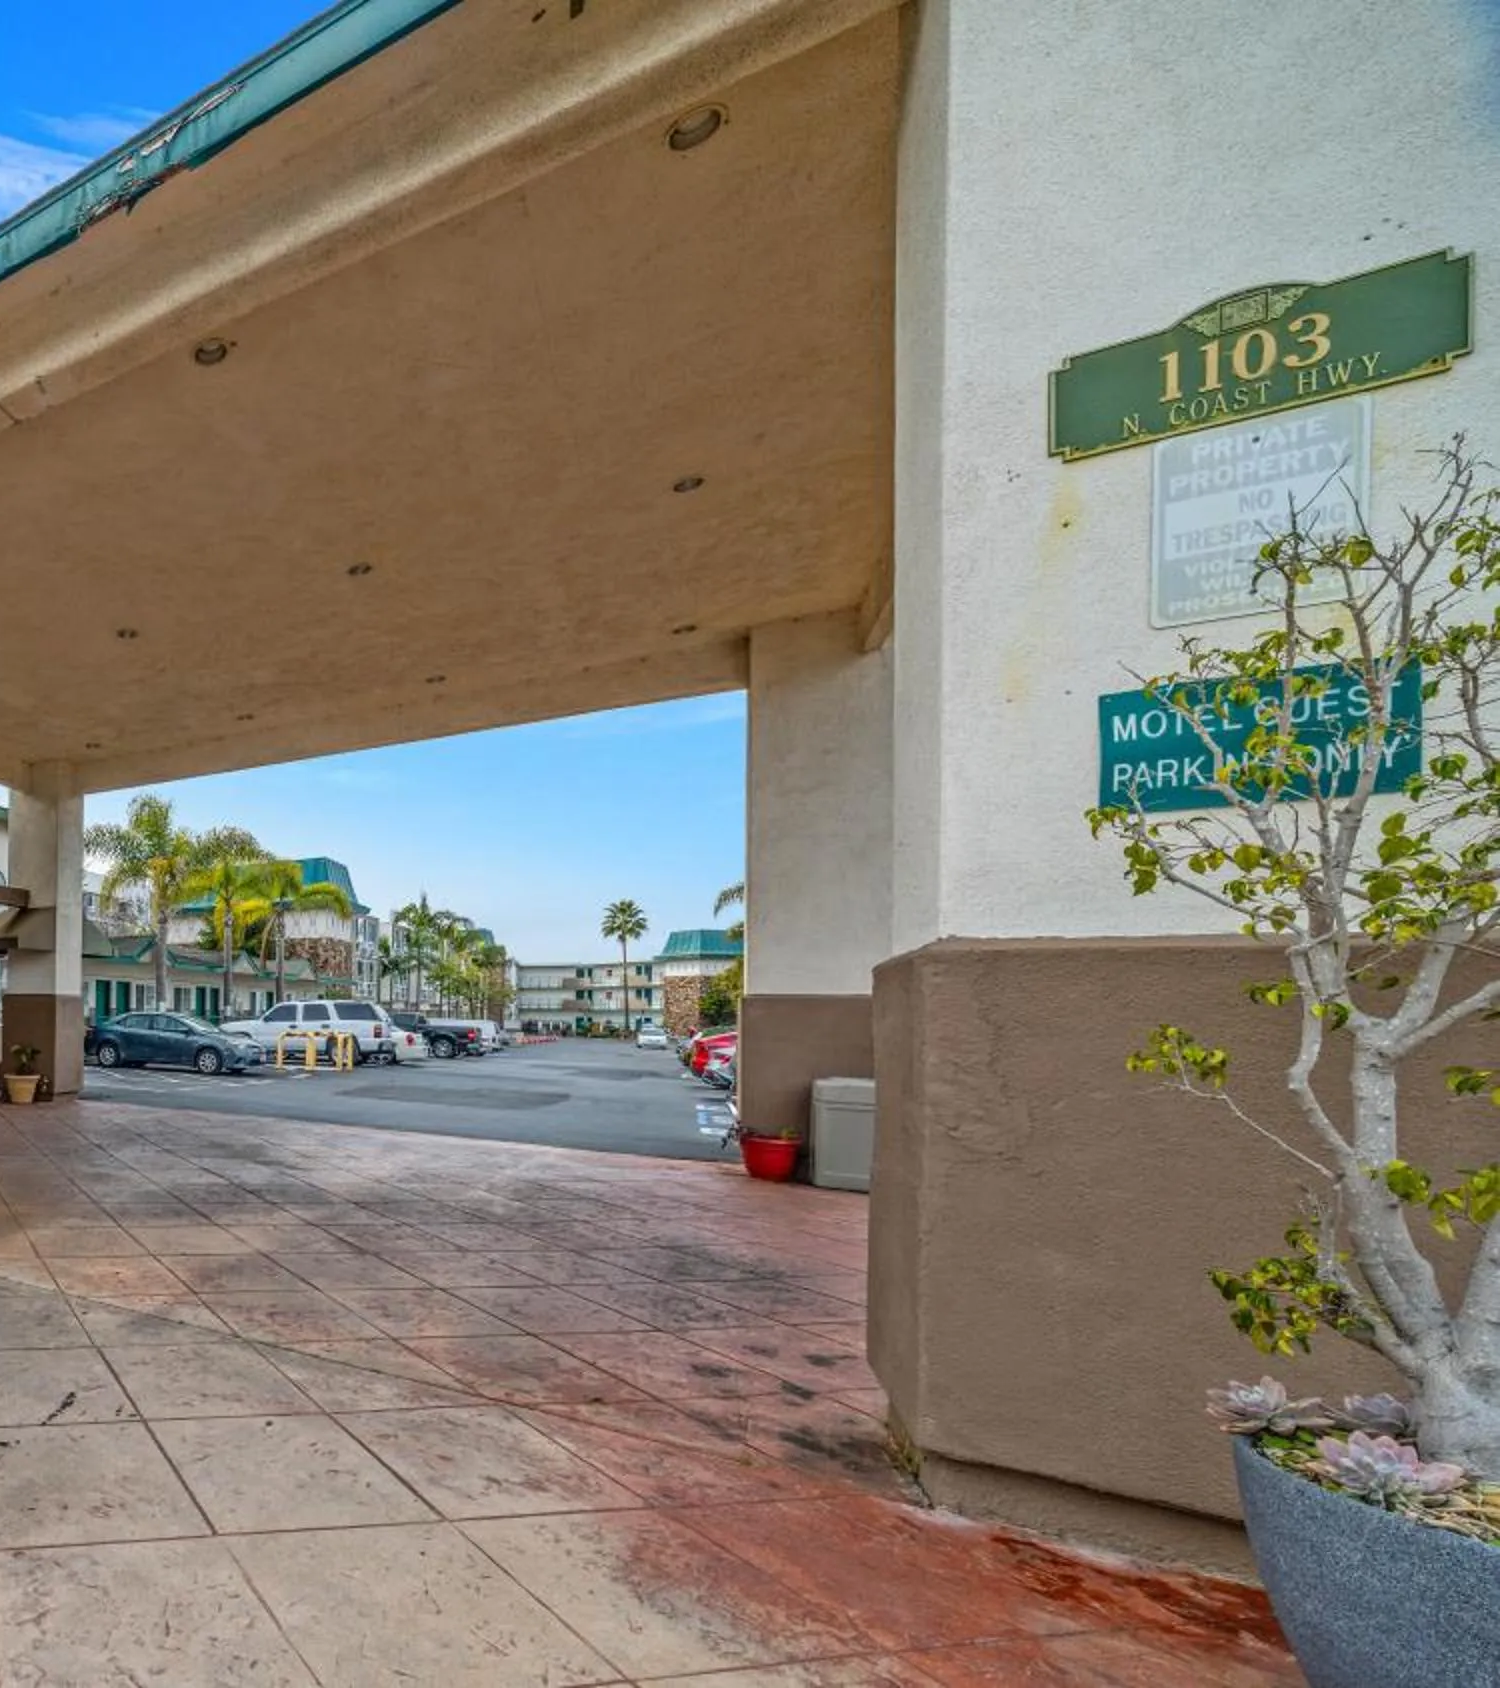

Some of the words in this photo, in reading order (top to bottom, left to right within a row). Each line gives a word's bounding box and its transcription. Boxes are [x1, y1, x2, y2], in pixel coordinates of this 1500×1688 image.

[1159, 313, 1332, 403] 1103
[1169, 380, 1272, 426] COAST
[1192, 413, 1330, 465] PRIVATE
[1169, 437, 1349, 497] PROPERTY
[1238, 488, 1274, 514] NO
[1172, 502, 1348, 553] TRESPASING
[1112, 701, 1243, 743] MOTEL
[1112, 747, 1286, 793] PARKN
